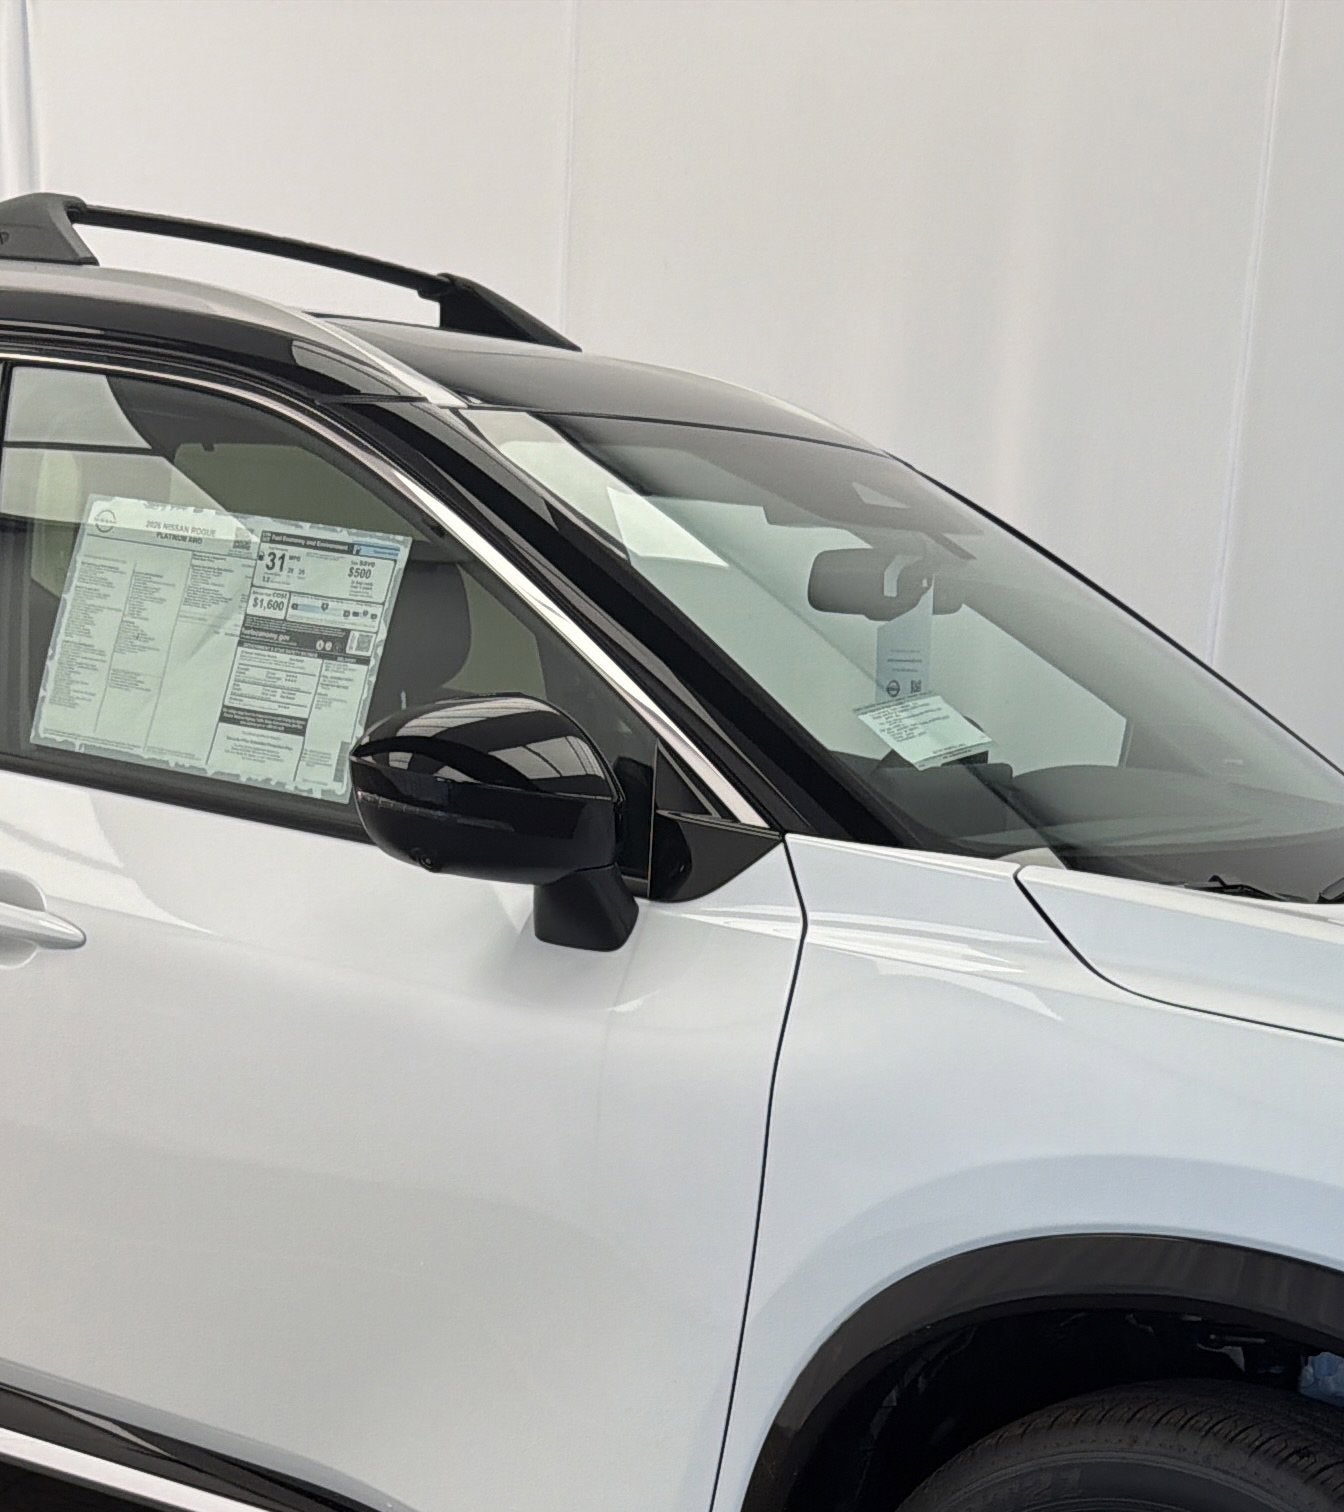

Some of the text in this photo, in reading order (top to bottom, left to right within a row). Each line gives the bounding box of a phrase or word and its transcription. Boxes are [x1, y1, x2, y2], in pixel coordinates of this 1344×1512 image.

[156, 532, 188, 542] PLATINUM
[162, 523, 189, 533] NISSAN
[191, 527, 216, 537] ROGUE
[265, 552, 286, 572] 31
[348, 566, 372, 580] $500
[252, 597, 284, 611] $1,600
